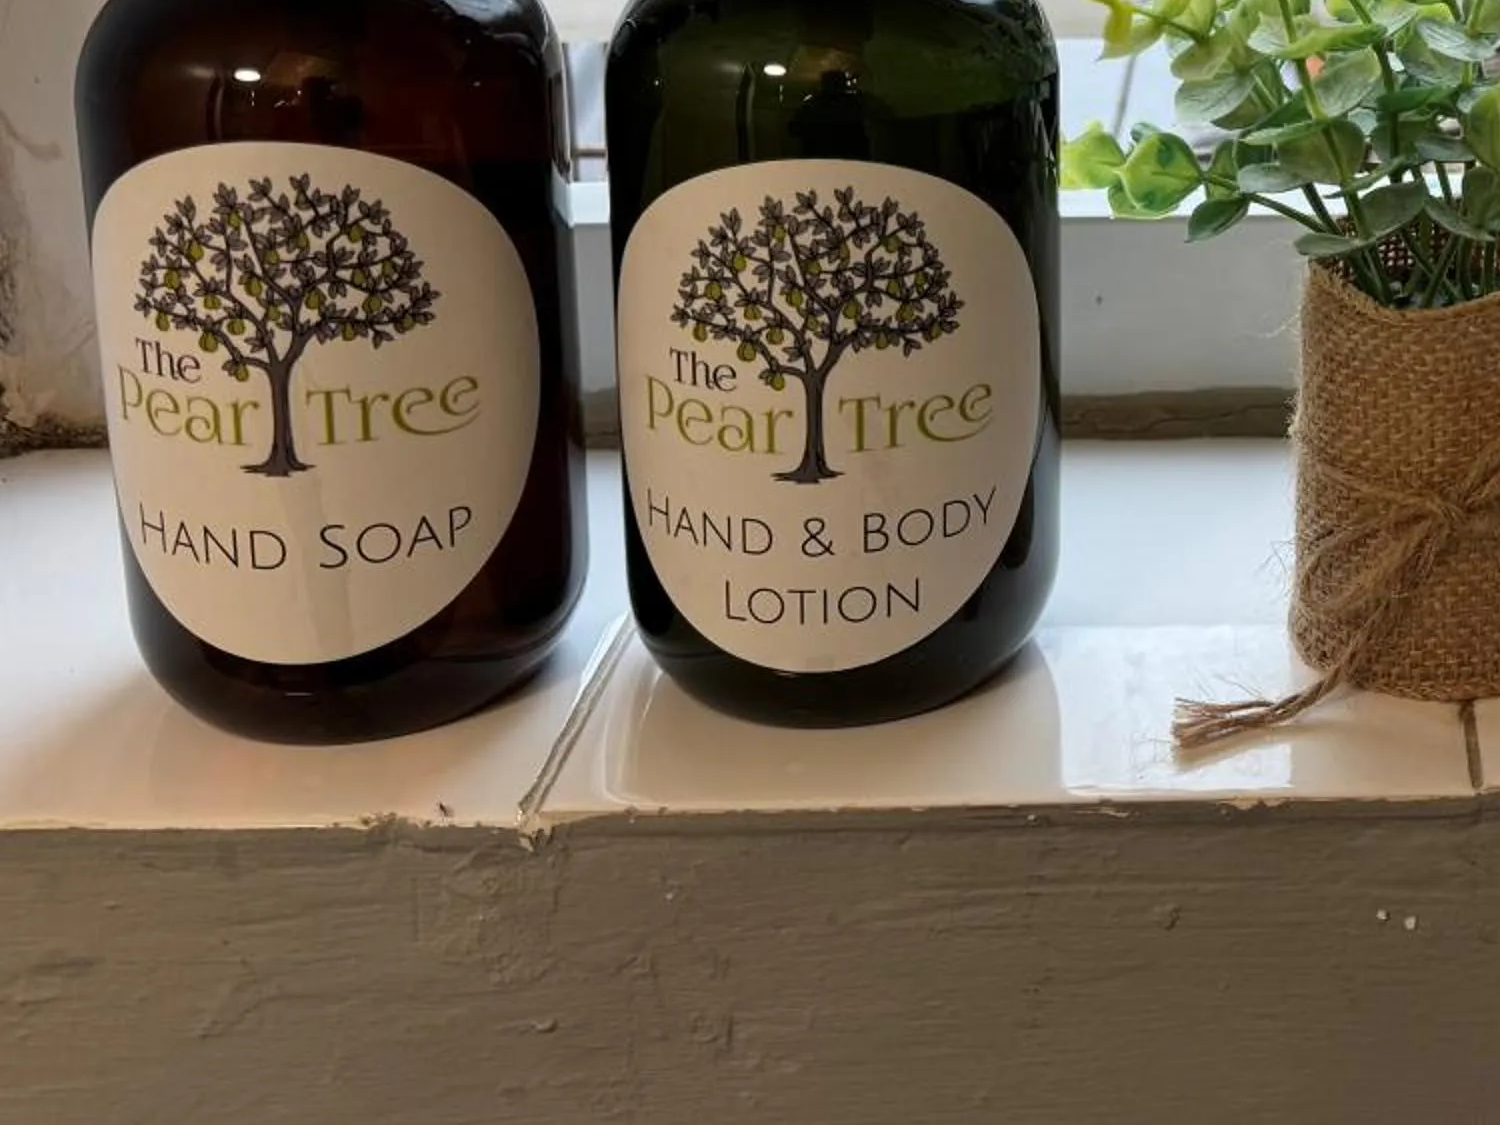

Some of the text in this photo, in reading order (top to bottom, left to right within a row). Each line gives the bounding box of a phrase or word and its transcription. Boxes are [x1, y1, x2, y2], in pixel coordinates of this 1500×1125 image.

[136, 337, 201, 383] The
[669, 347, 737, 393] The
[117, 364, 482, 447] Pear Tree
[644, 373, 994, 455] Pear Tree
[139, 502, 472, 571] HAND SOAP
[646, 485, 997, 558] HAND & BODY
[724, 577, 921, 625] LOTION
